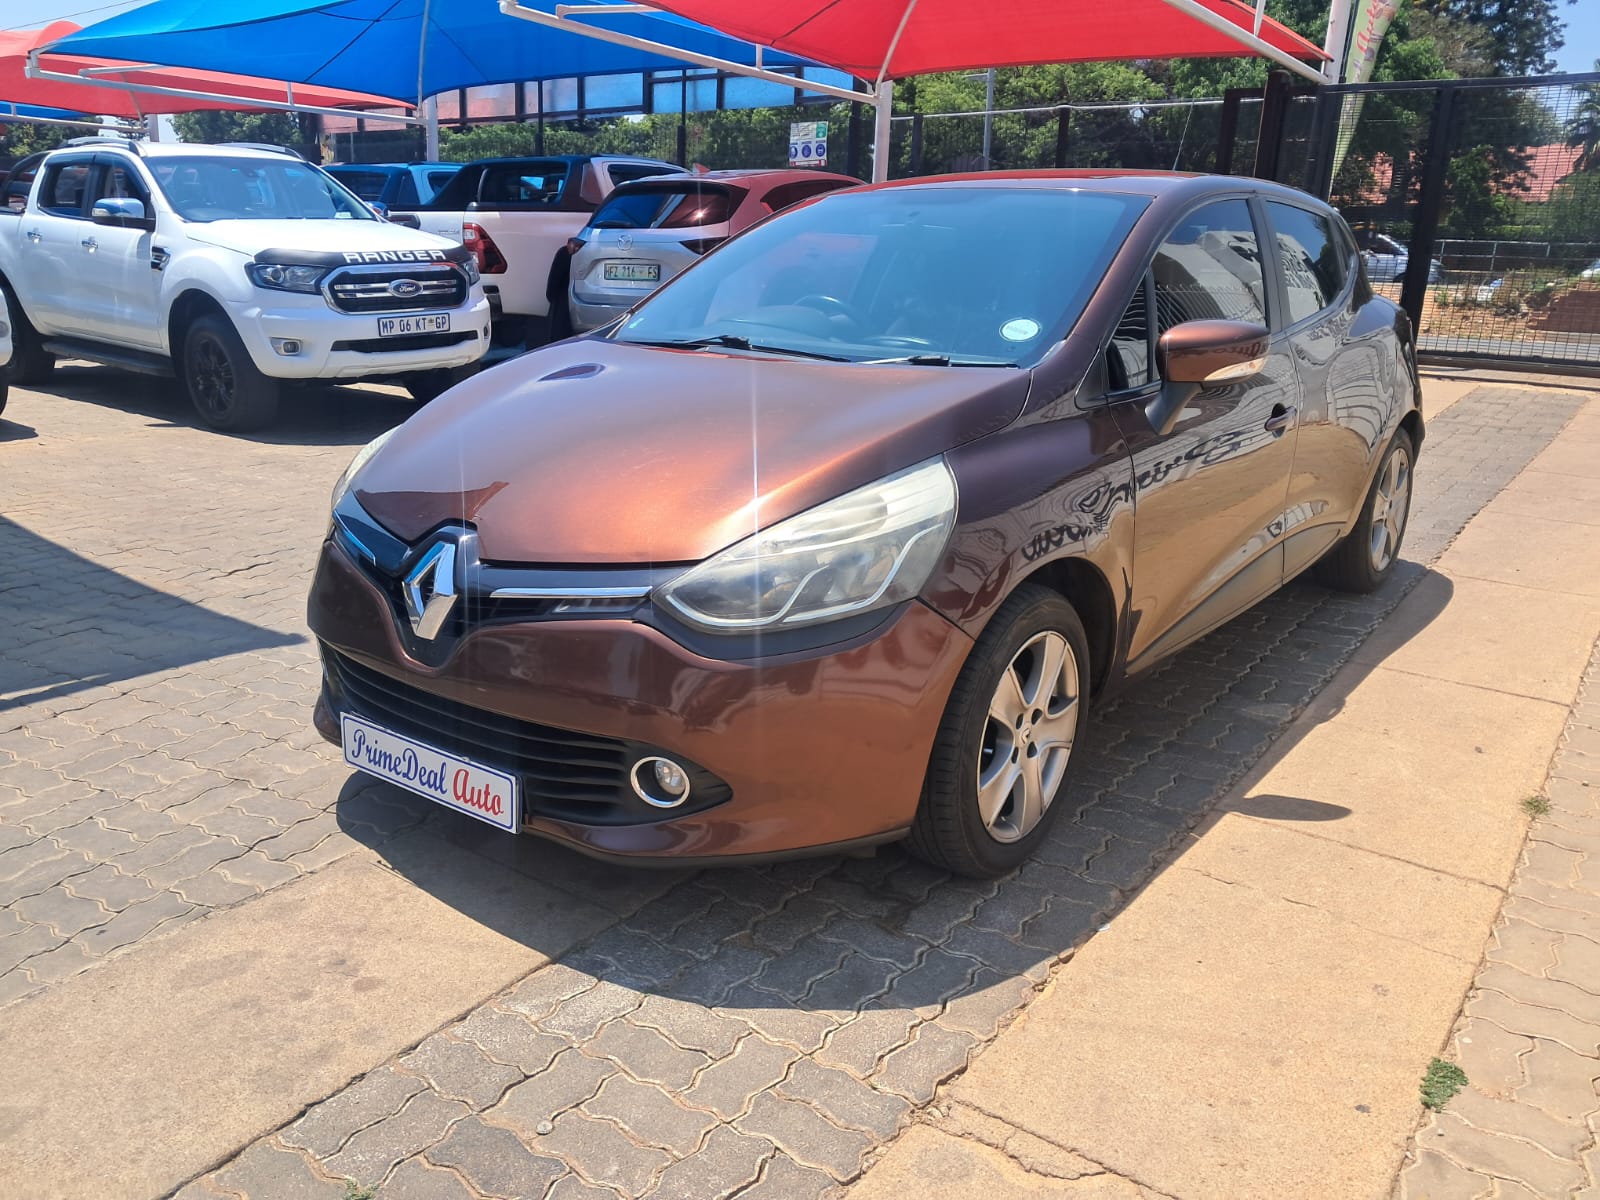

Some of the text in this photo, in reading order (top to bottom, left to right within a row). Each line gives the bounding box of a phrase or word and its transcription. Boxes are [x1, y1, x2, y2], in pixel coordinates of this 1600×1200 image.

[342, 250, 447, 263] RANGER
[647, 266, 658, 279] FS
[382, 315, 447, 334] MP 06 KT GP
[351, 728, 504, 816] PrimeDeal Auto
